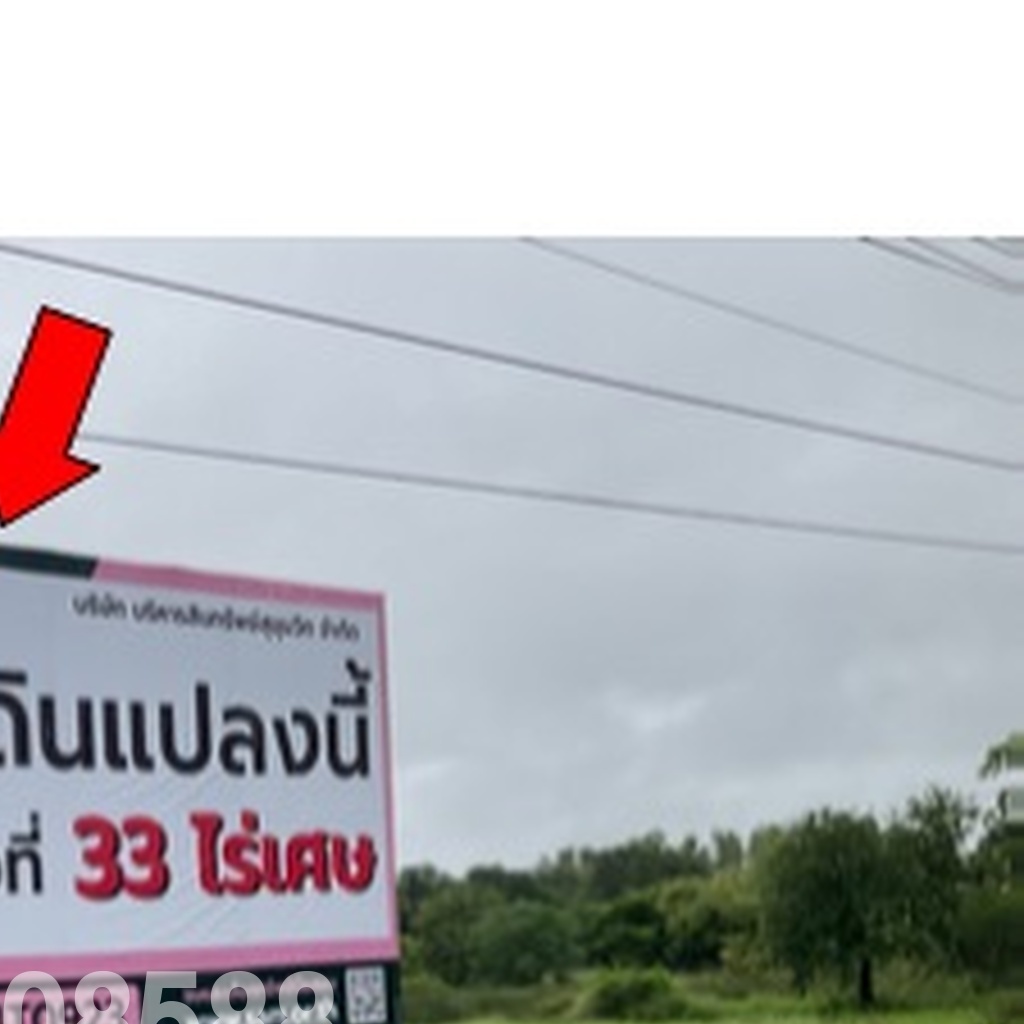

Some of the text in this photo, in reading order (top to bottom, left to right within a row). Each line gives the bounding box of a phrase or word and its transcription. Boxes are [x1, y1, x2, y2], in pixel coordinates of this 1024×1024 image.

[73, 813, 172, 902] 33
[190, 809, 378, 897] ไร่เศษ
